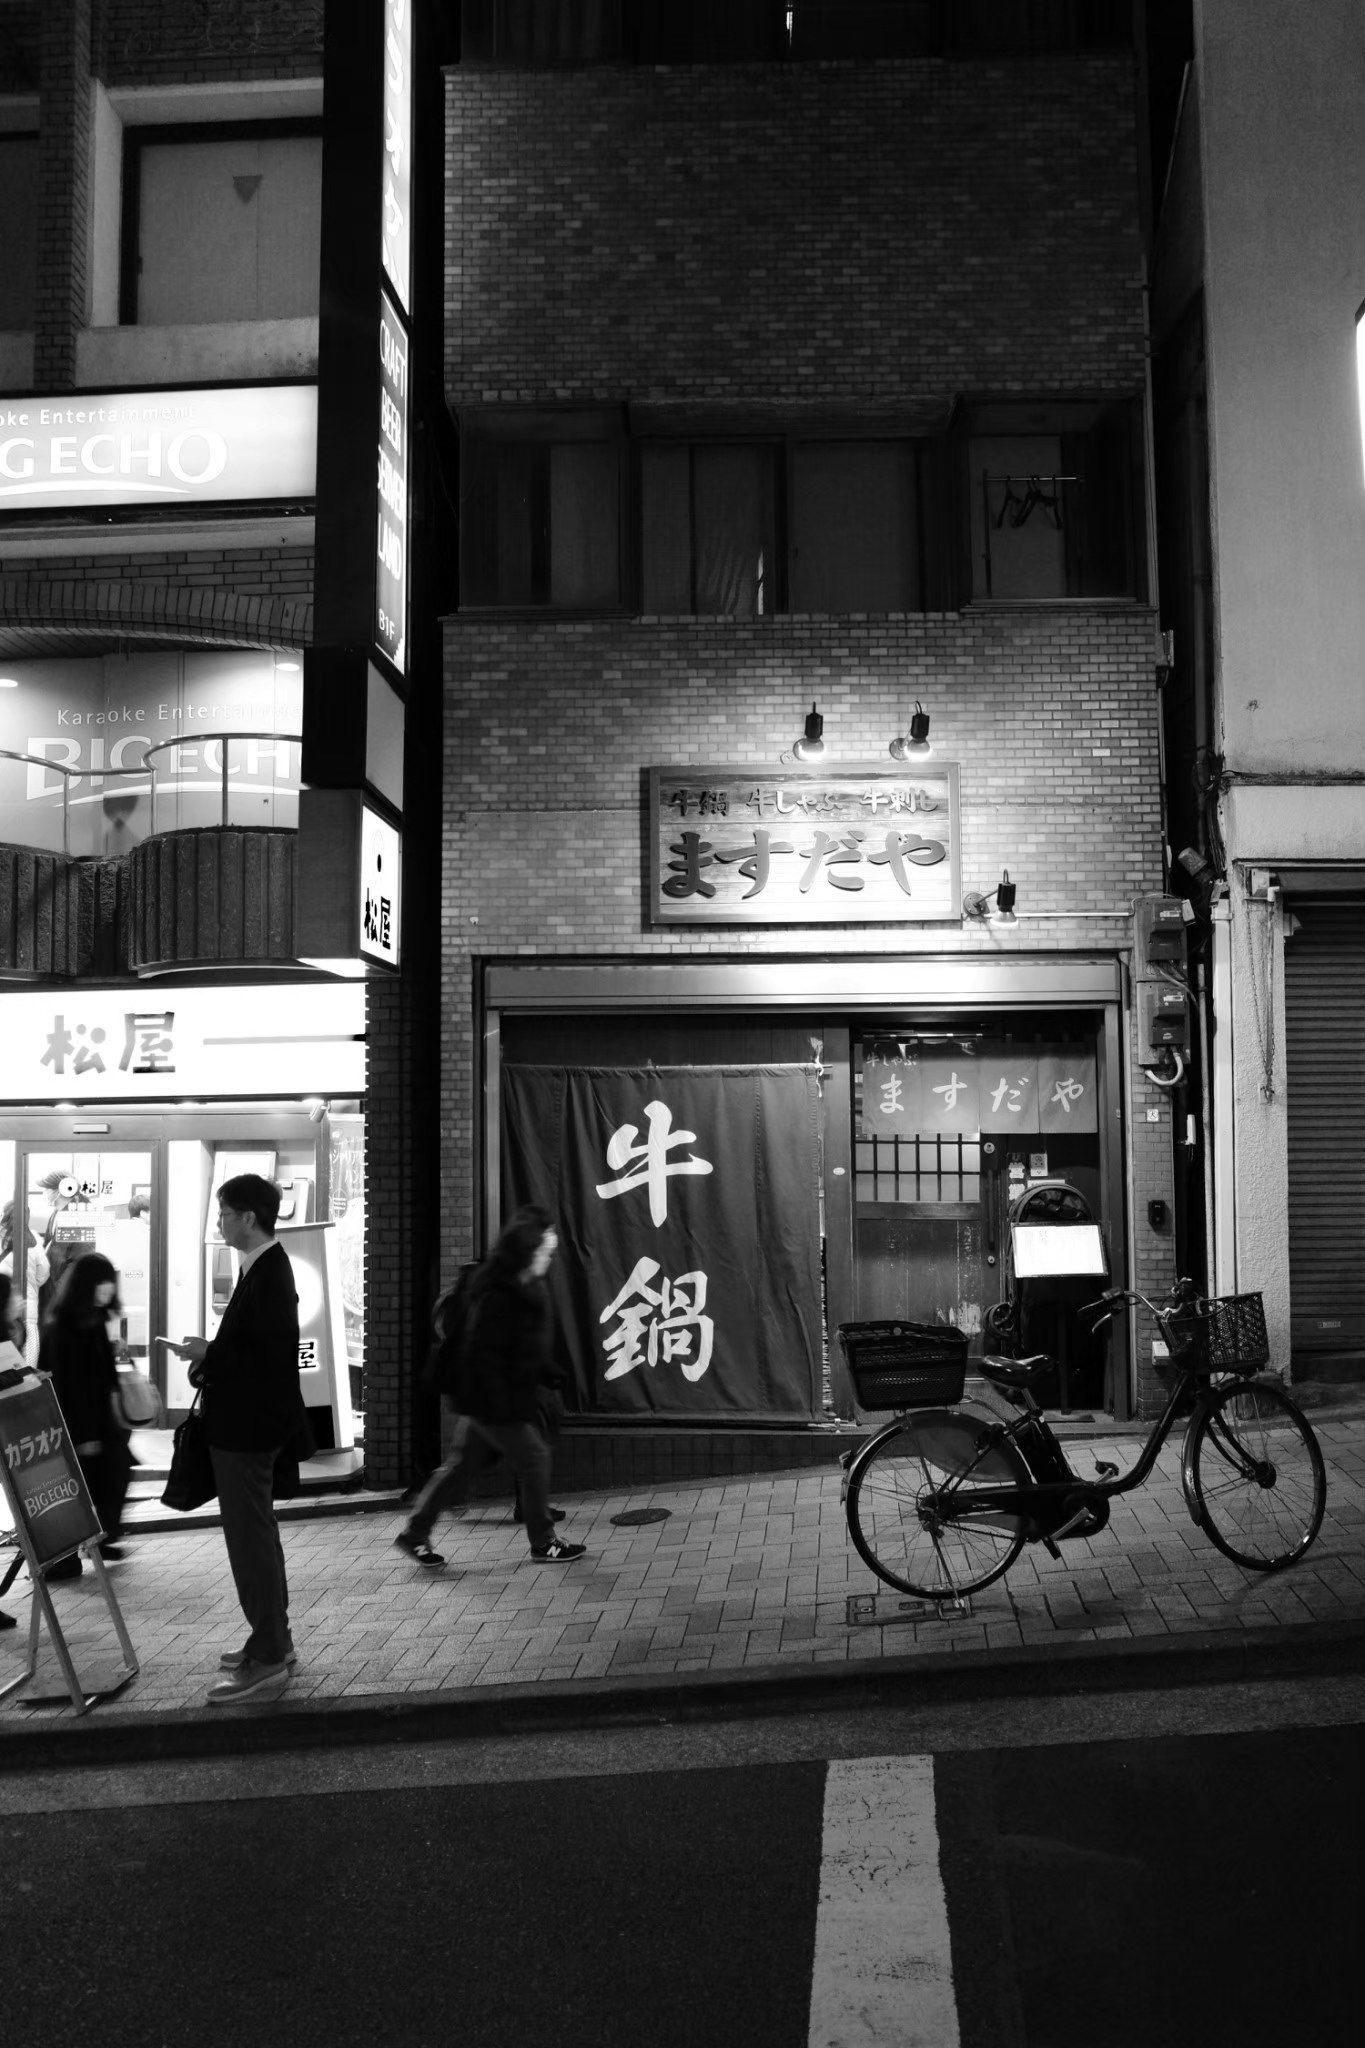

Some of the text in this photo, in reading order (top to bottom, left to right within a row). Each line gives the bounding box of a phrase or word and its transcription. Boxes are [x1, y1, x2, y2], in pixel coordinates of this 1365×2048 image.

[379, 318, 406, 397] CRAFT
[40, 403, 196, 426] Entertainment
[381, 386, 402, 456] BEER
[50, 426, 229, 485] ECHO
[377, 512, 402, 581] LAND
[378, 608, 396, 641] B1F
[57, 704, 146, 726] Karaoke
[26, 733, 302, 800] BIG ECH
[746, 788, 843, 816] 牛しゃぶ
[859, 787, 939, 815] 牛刺し
[661, 830, 947, 900] ますだや
[364, 887, 391, 950] 松屋
[40, 1011, 176, 1076] 松屋
[879, 1072, 1084, 1113] ますだや
[80, 1179, 114, 1196] 松屋
[595, 1100, 714, 1382] 牛鍋
[4, 1426, 63, 1470] カラオケ
[24, 1492, 49, 1519] BIG
[48, 1477, 80, 1502] ECHO
